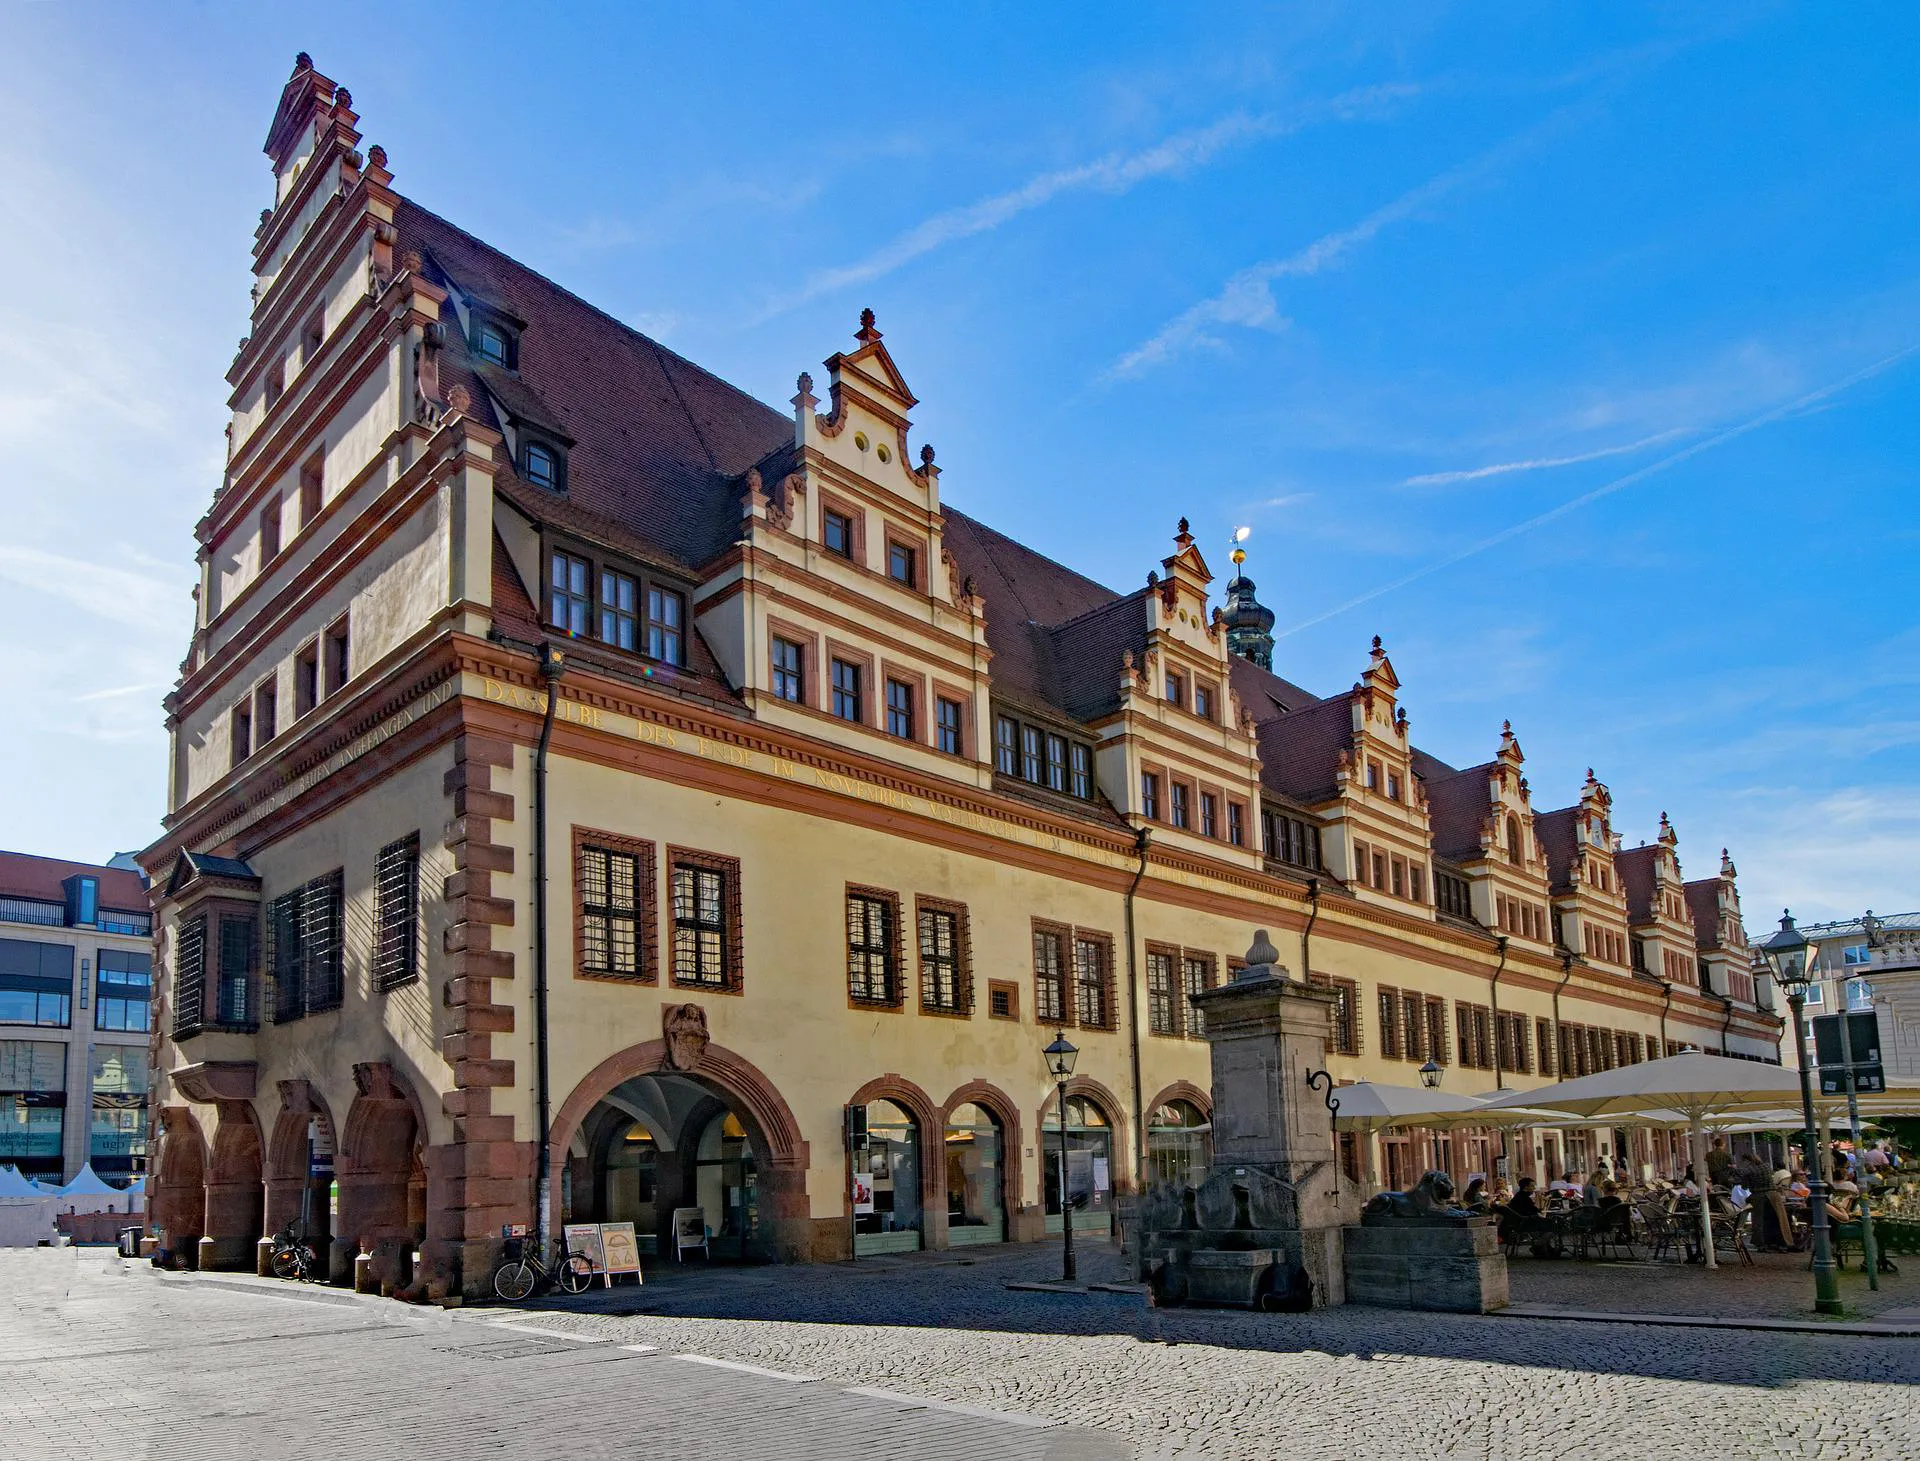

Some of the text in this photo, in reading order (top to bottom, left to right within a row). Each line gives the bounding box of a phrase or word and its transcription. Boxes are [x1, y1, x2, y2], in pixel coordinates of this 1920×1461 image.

[339, 705, 414, 767] ANGEFANGEN
[423, 681, 453, 714] UND
[485, 679, 604, 731] DASSLBE
[636, 721, 677, 748] DES
[697, 738, 753, 768] ENDE
[772, 758, 795, 778] IM
[814, 768, 914, 810] NOVEMBRIS
